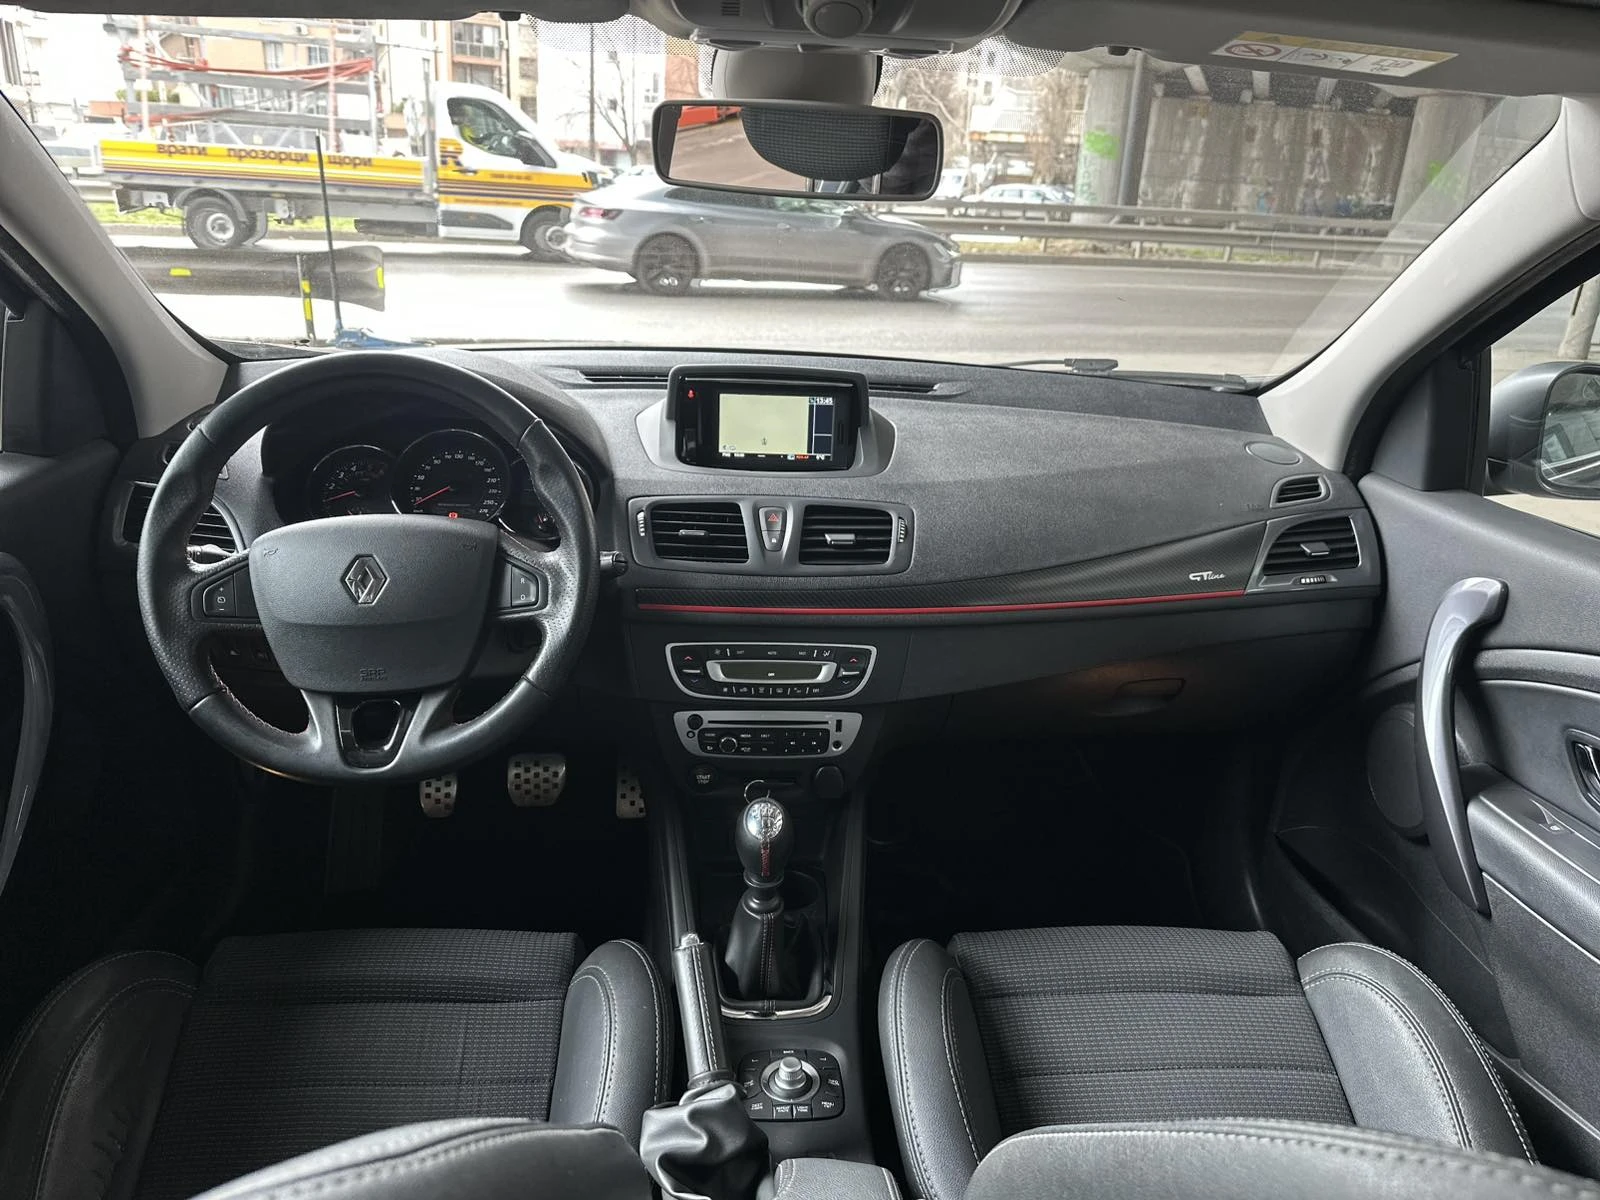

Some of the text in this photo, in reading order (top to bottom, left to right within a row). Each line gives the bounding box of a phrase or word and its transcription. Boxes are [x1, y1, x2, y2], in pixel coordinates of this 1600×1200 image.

[156, 143, 373, 169] врати прозорци щори
